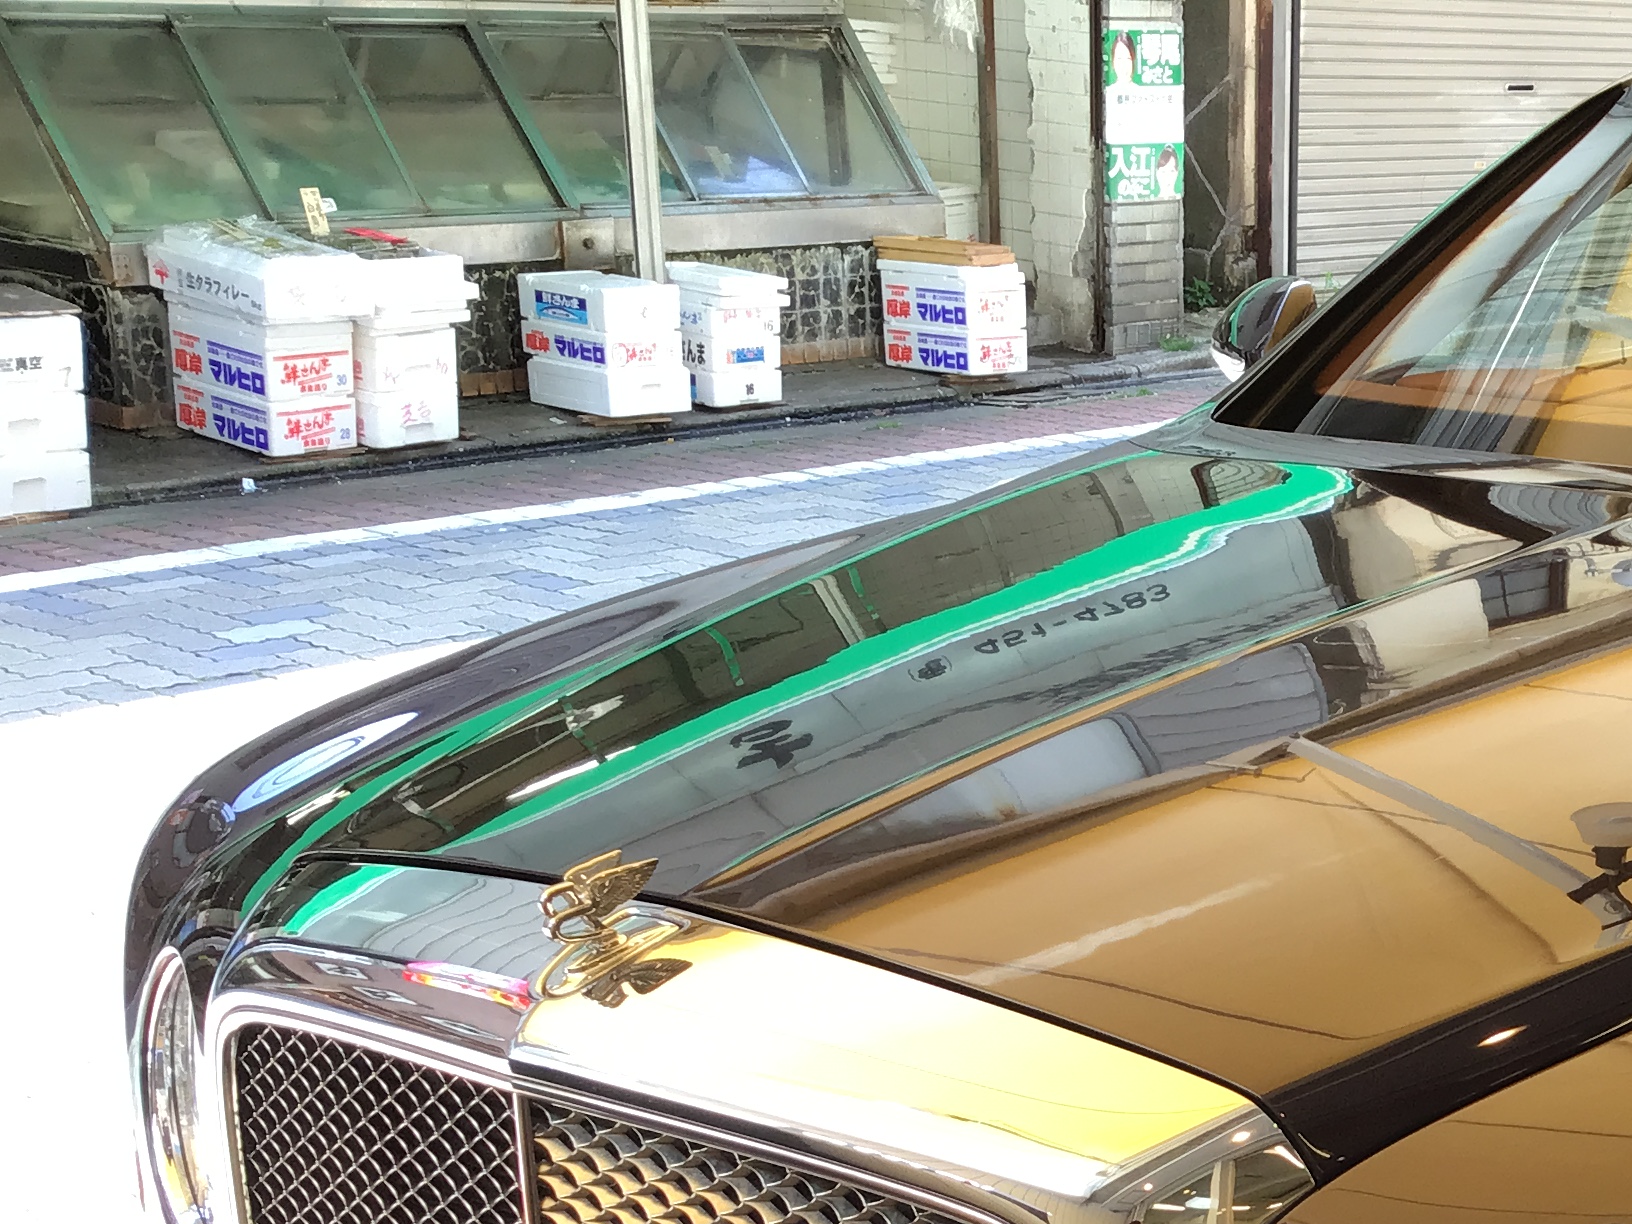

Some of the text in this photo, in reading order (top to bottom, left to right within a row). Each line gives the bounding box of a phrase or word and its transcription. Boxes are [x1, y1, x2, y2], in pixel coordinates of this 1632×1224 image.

[1107, 145, 1152, 178] 入江
[916, 302, 967, 326] マルヒロ
[554, 337, 606, 365] マルヒロ
[918, 346, 969, 371] マルヒロ
[208, 358, 266, 397] マルヒロ
[336, 374, 348, 386] 30
[212, 412, 270, 452] マルヒロ
[340, 428, 351, 440] 28
